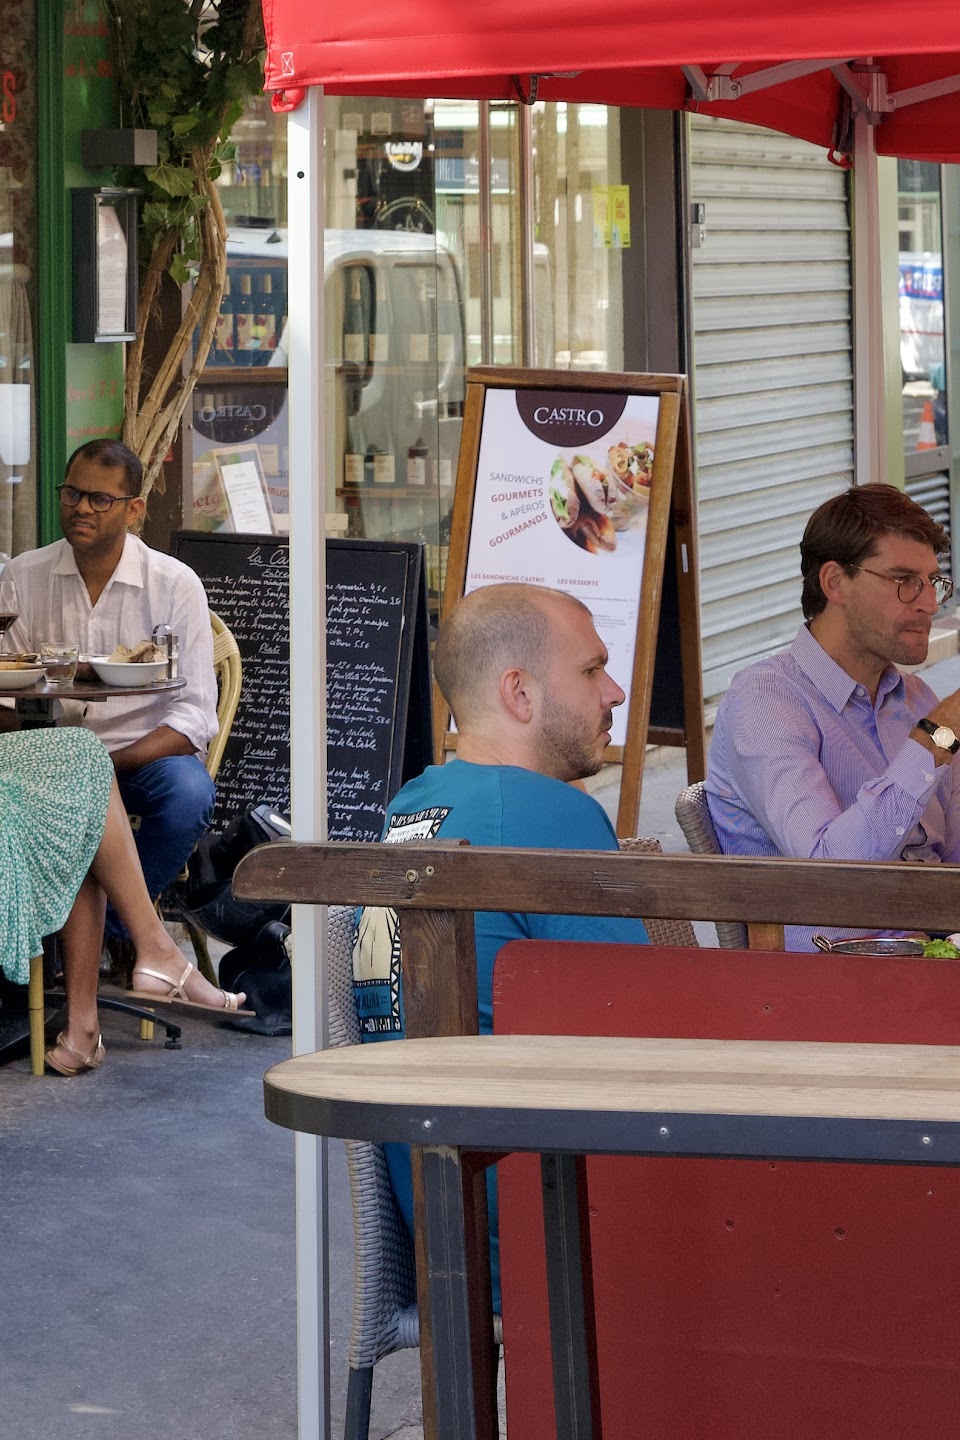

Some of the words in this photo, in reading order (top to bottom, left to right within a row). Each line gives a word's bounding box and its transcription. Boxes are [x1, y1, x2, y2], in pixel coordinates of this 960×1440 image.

[534, 406, 604, 427] CASTRO
[489, 471, 544, 486] SANDWICHS
[490, 488, 544, 503] GOURMETS
[500, 512, 508, 521] &
[509, 499, 545, 518] APÉROS
[489, 511, 548, 547] GOURMANDS
[482, 574, 519, 582] SANDWICHS
[569, 579, 599, 587] DESSERTS
